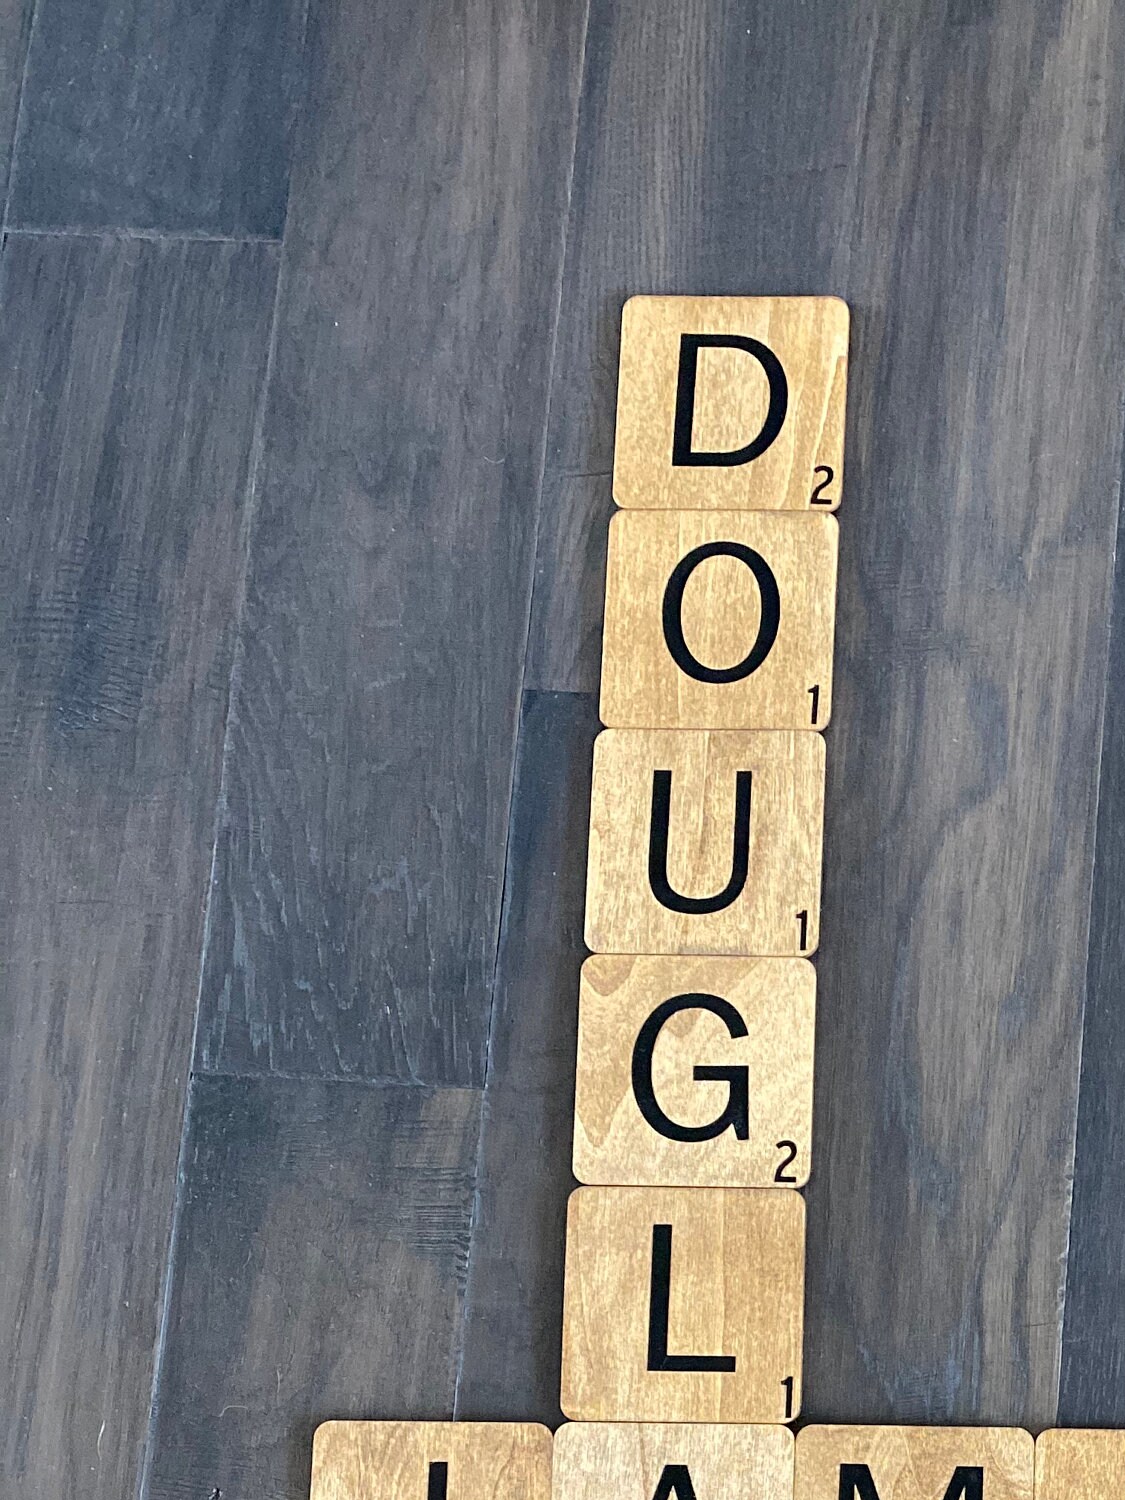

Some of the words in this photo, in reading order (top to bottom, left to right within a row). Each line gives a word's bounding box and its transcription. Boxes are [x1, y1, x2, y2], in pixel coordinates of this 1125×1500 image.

[811, 466, 833, 504] 2
[808, 685, 819, 724] 1
[796, 910, 807, 950] 1
[774, 1141, 797, 1182] 2
[781, 1376, 793, 1419] 1
